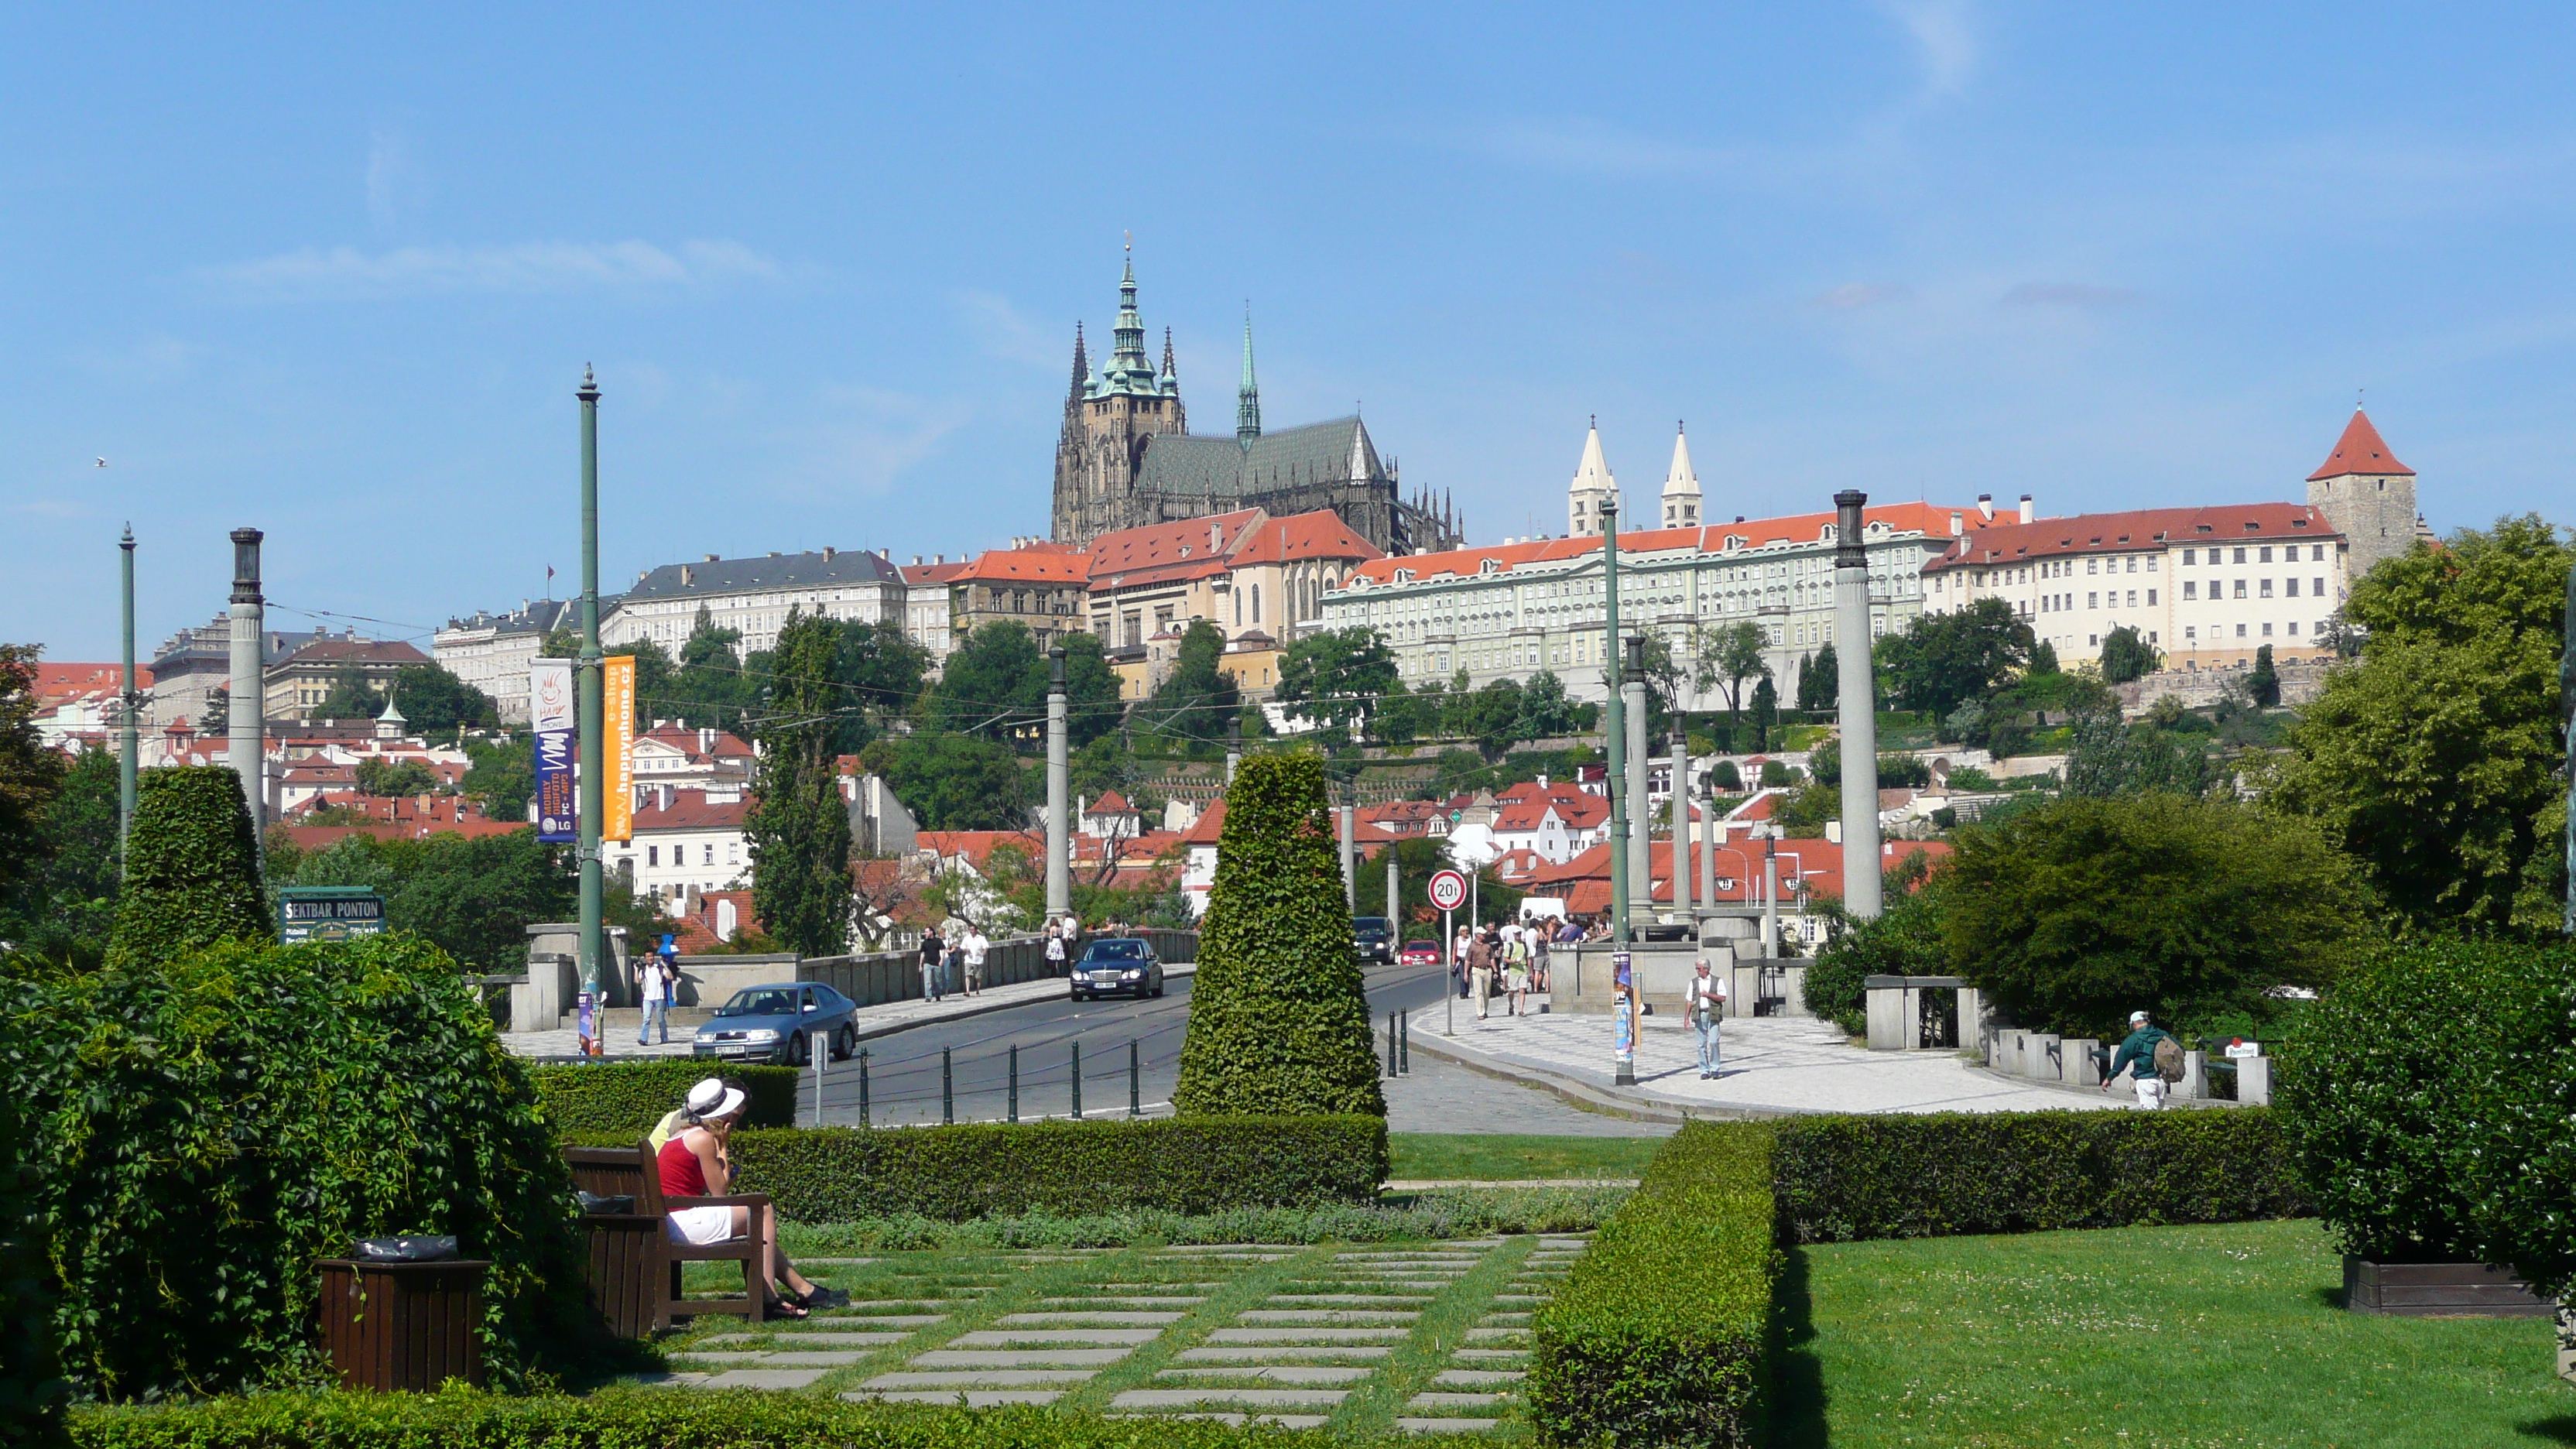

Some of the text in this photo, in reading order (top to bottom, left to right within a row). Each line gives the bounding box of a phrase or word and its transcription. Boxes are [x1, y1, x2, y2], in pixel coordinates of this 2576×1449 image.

[605, 666, 619, 722] e-shop
[552, 772, 560, 815] DIGIFOTO
[561, 773, 570, 794] MP3
[543, 780, 552, 815] MOBILY
[562, 802, 570, 815] PC
[558, 821, 571, 831] LG
[286, 901, 379, 919] SEKTBAR PONTON
